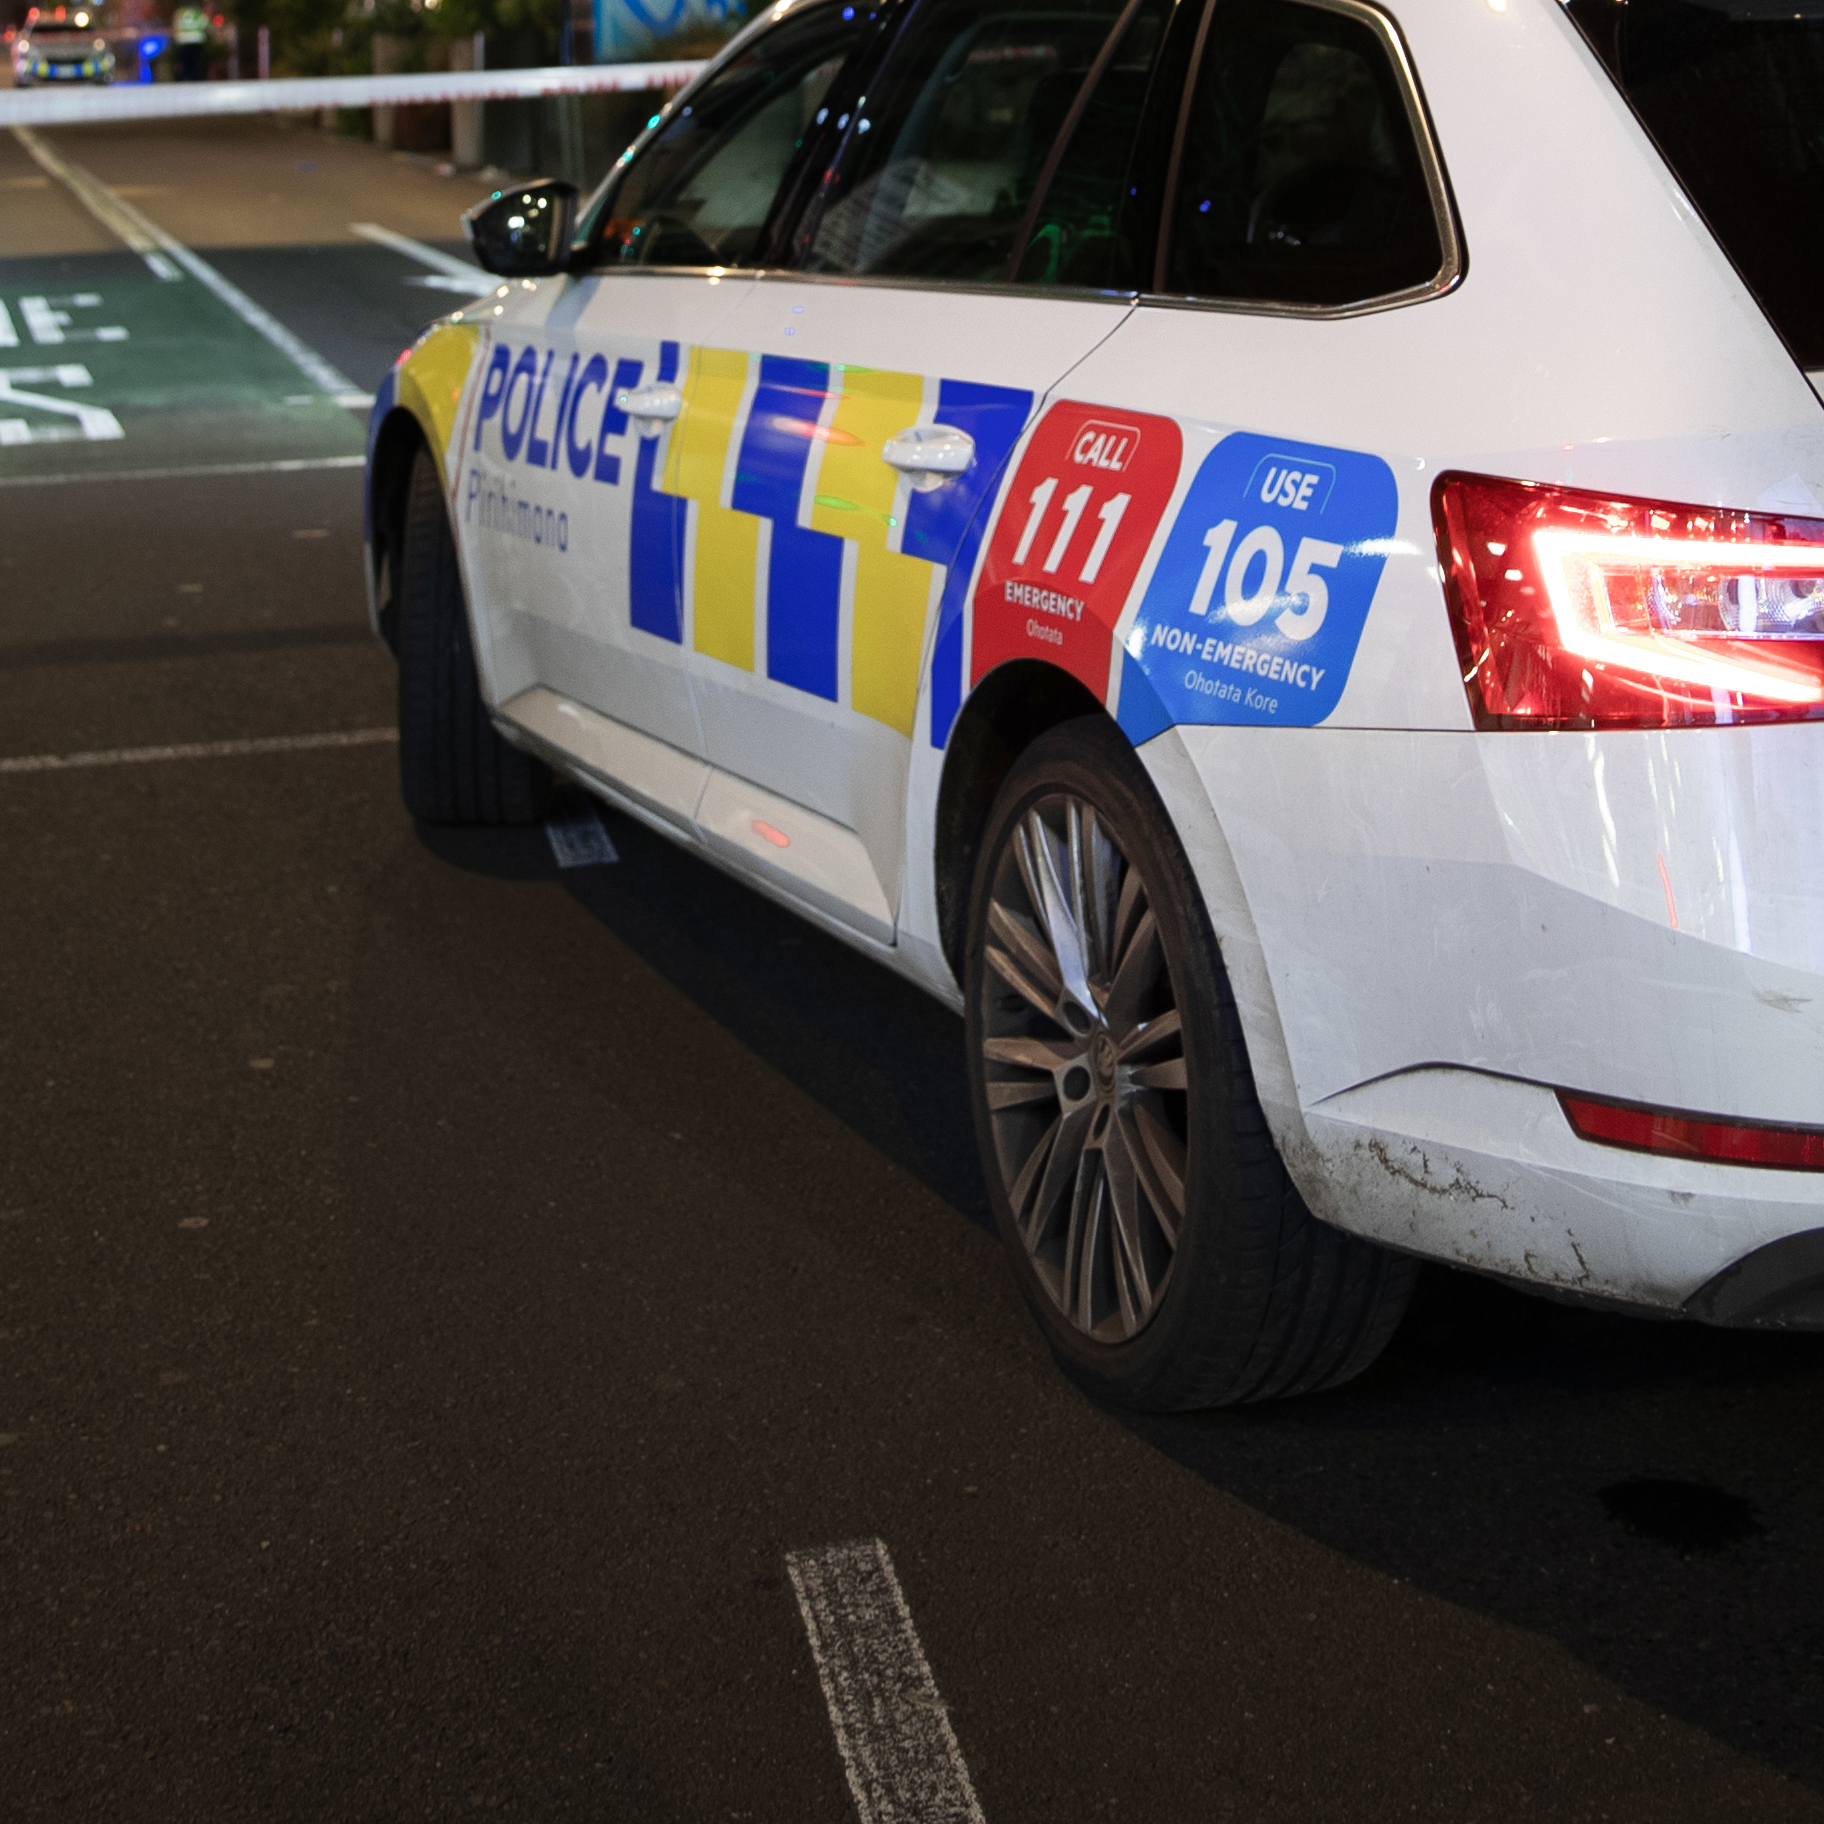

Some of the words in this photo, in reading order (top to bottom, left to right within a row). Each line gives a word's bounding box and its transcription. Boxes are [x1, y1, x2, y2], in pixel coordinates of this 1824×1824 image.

[473, 342, 645, 486] POLICE
[1073, 430, 1129, 472] CALL
[1260, 466, 1320, 512] USE
[1011, 476, 1132, 585] 111
[1004, 579, 1085, 623] EMERGENCY
[1188, 517, 1346, 642] 105
[1149, 622, 1328, 692] NON-EMERGENCY
[1184, 668, 1241, 705] Ohotata
[1243, 686, 1279, 715] Kore
